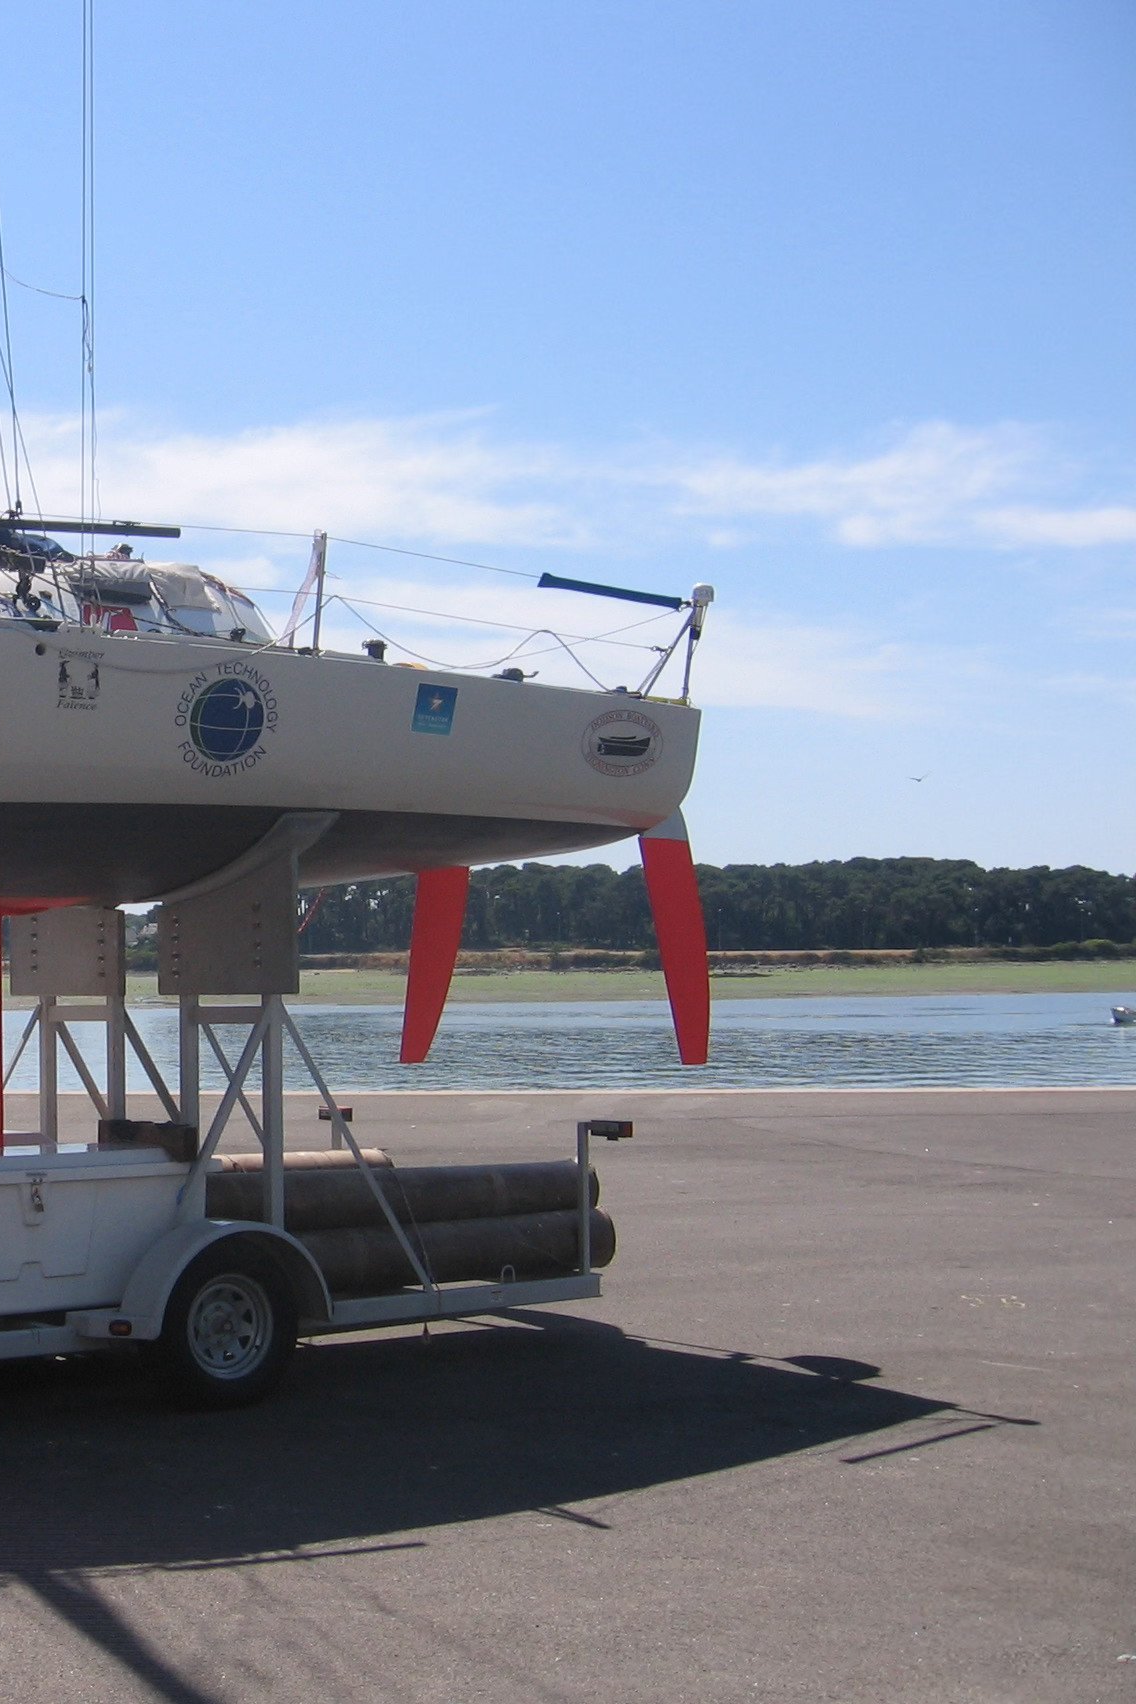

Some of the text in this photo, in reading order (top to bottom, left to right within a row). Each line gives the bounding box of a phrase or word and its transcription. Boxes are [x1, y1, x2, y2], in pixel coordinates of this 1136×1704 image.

[175, 661, 279, 733] OCEAN TECHNOLOGY
[178, 741, 267, 777] FOUNDATION
